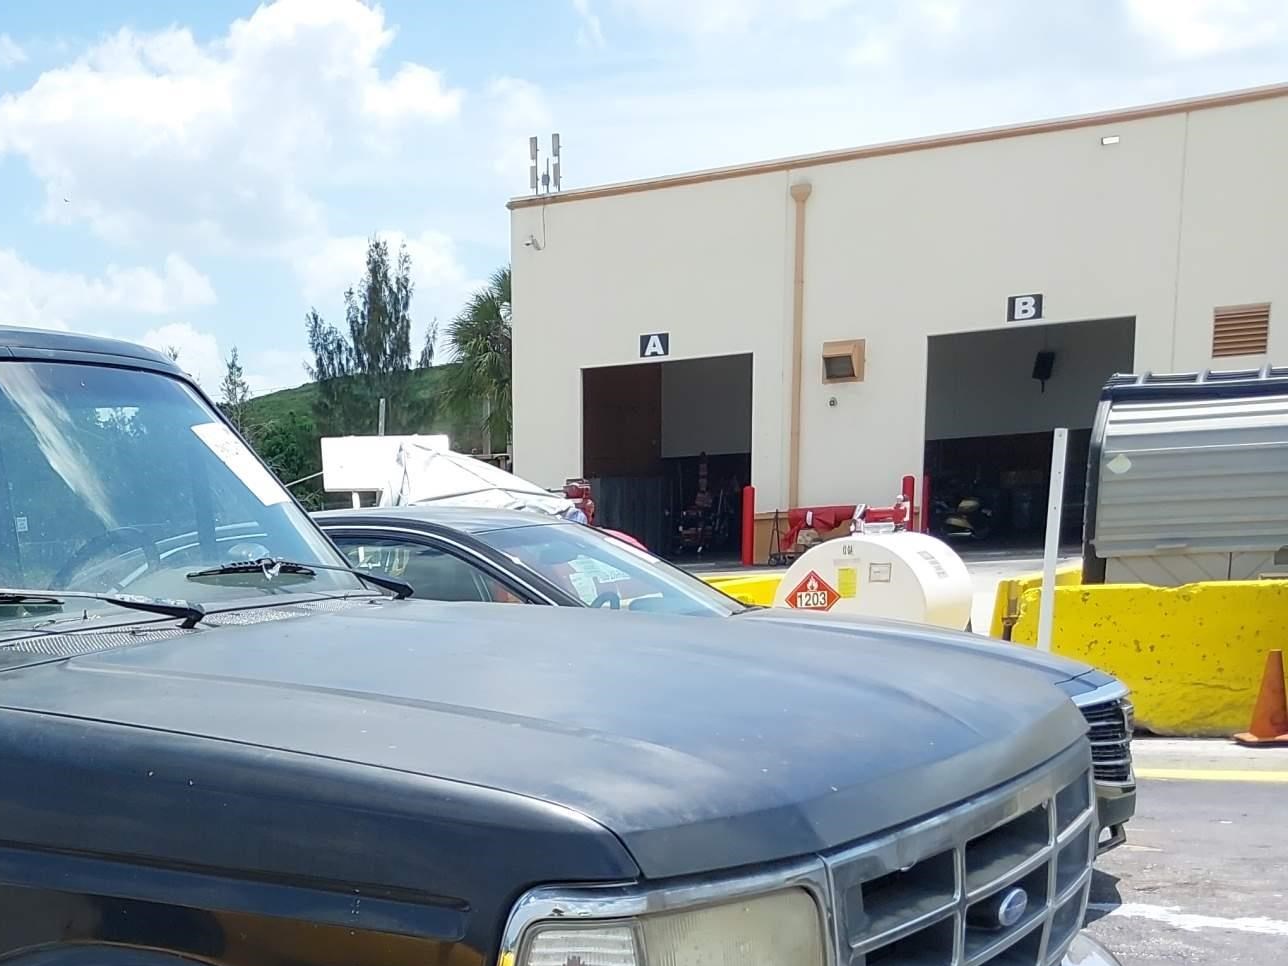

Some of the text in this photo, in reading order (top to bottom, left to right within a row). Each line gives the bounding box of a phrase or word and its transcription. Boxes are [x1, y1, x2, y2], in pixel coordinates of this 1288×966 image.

[1013, 295, 1036, 320] B
[643, 335, 665, 356] A
[797, 592, 827, 607] 1203
